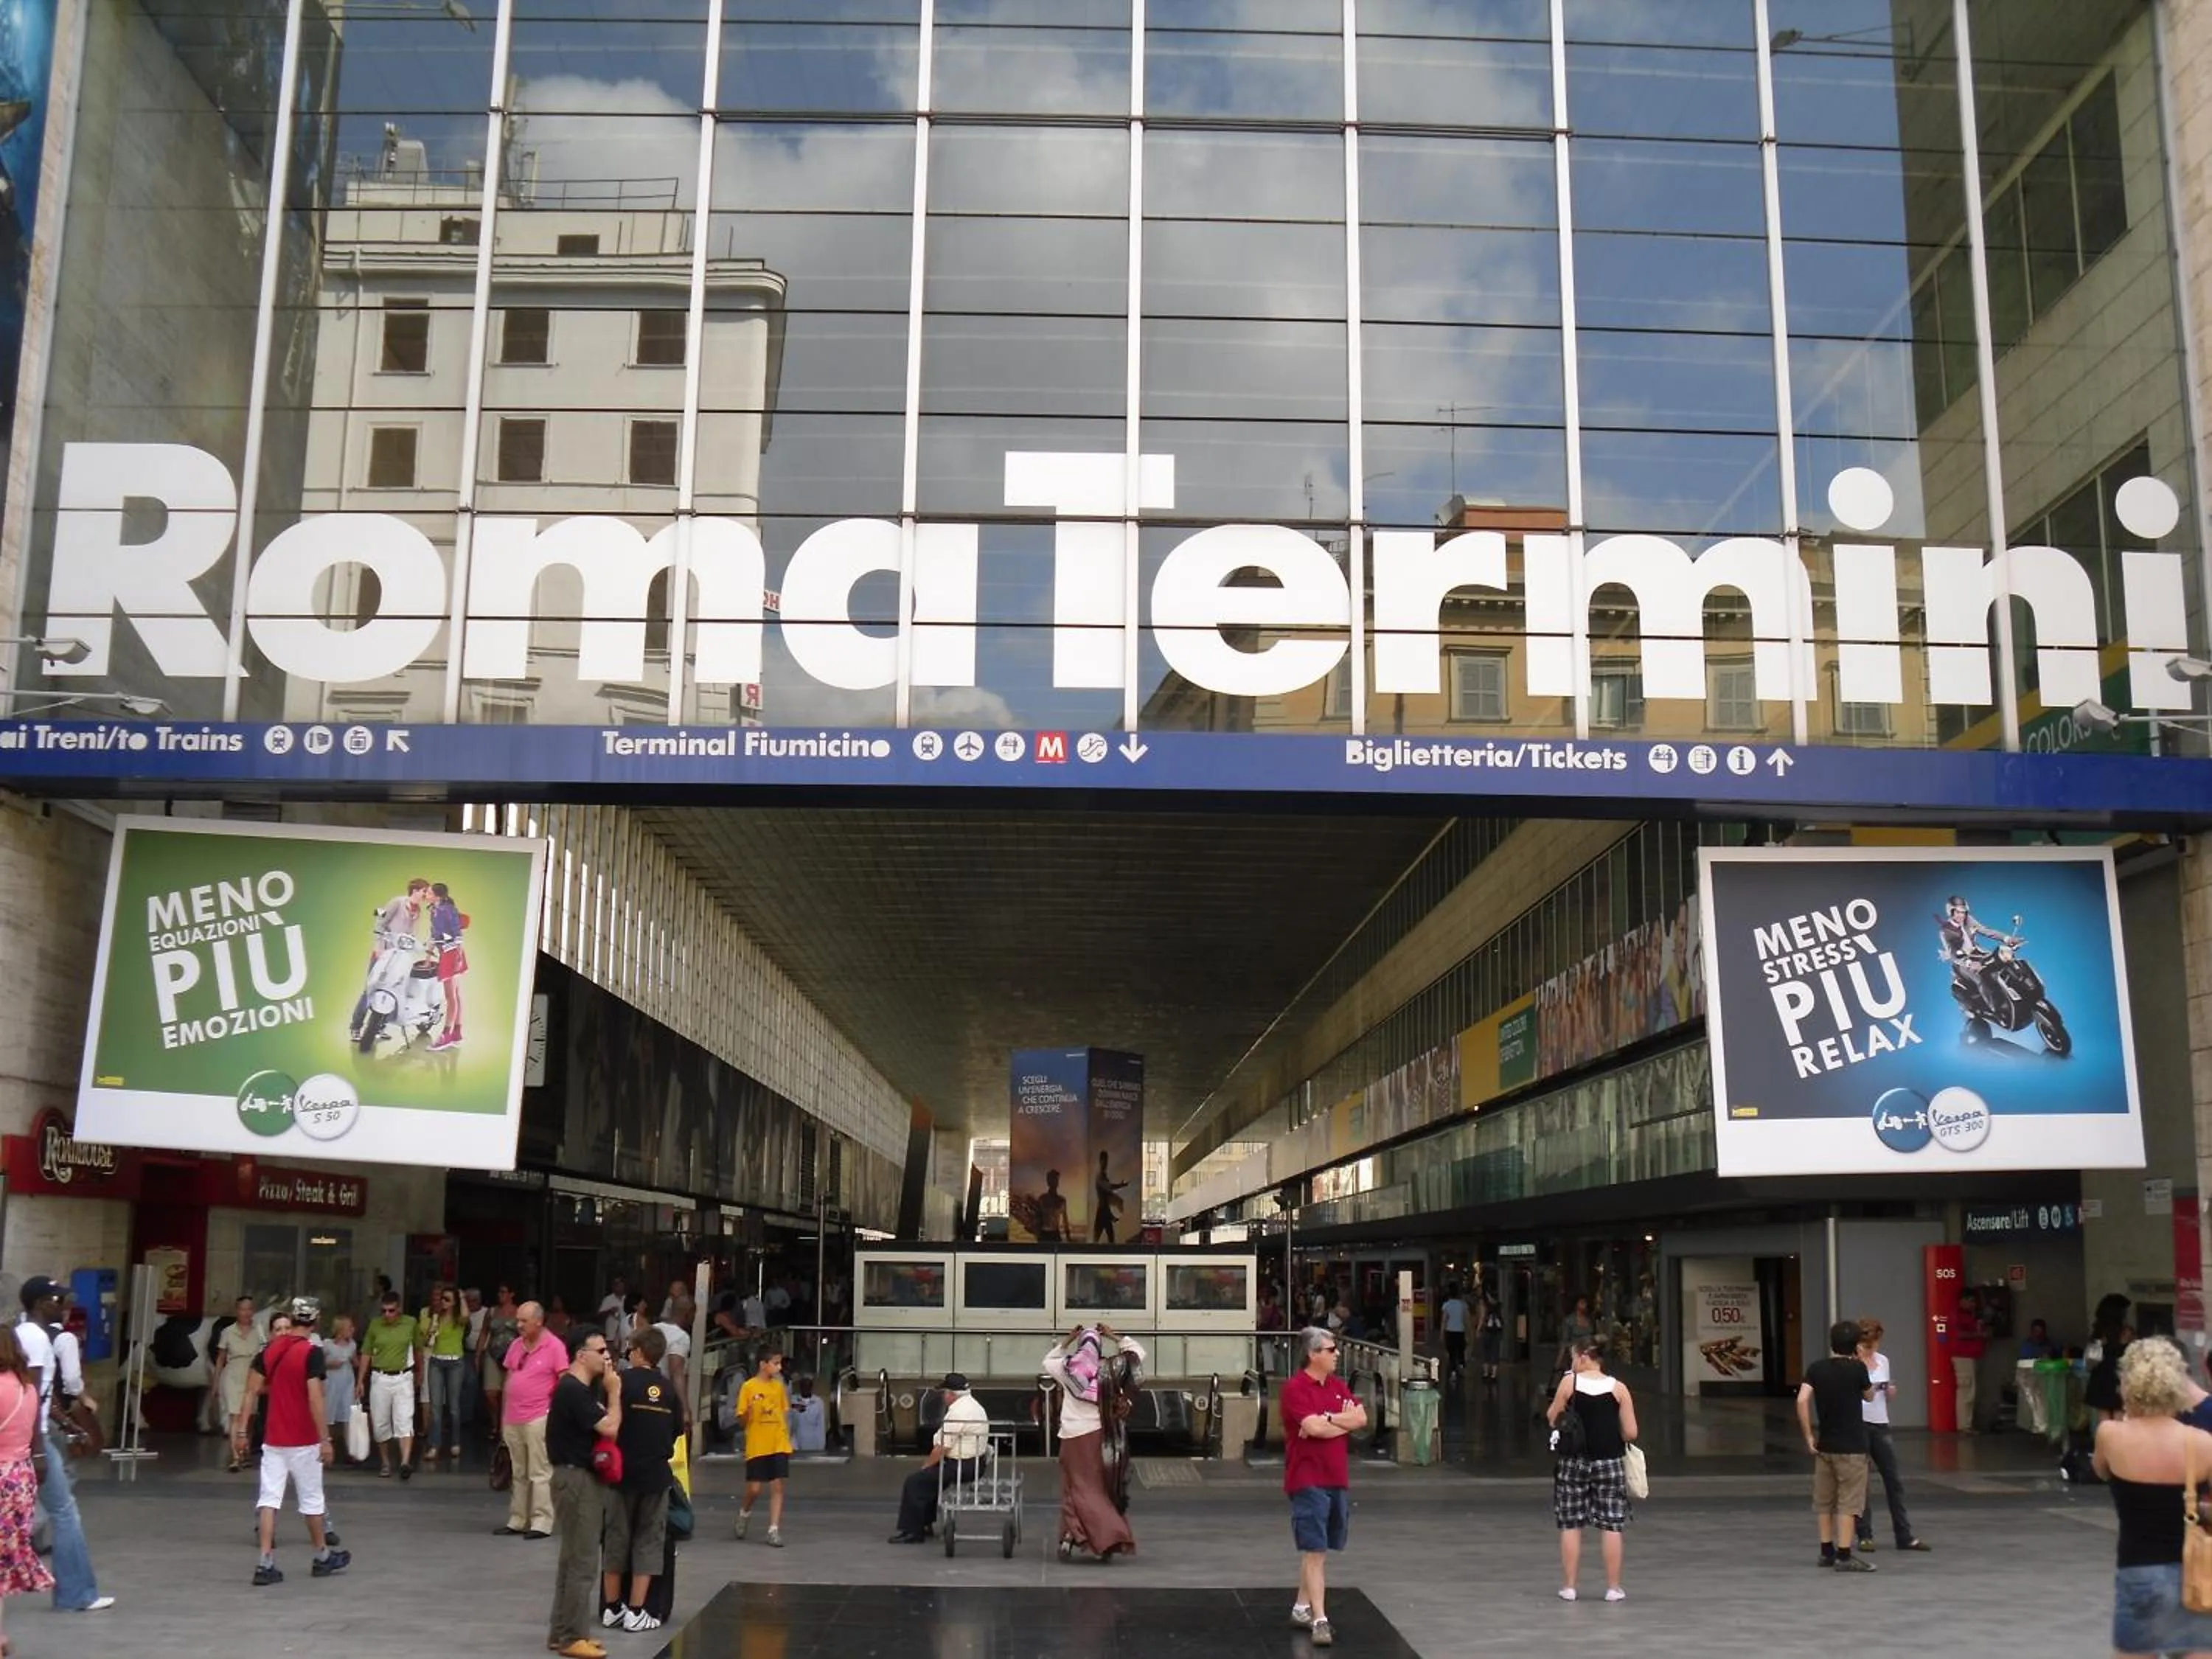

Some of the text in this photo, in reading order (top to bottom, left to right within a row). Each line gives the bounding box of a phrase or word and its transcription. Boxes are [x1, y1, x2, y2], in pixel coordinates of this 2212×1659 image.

[43, 442, 2192, 710] Roma Termini
[34, 725, 147, 751] Treni/to
[156, 726, 243, 751] Trains
[602, 731, 891, 758] Terminal Fiumicino
[1346, 740, 1627, 772] Biglietteria/Tickets
[147, 870, 295, 933] MENO
[148, 914, 261, 952] EQUAZIONI
[1753, 898, 1878, 961] MENO
[151, 911, 307, 1024] PIÙ
[1762, 938, 1857, 983] STRESS
[1770, 933, 1907, 1047] PIÙ
[161, 996, 316, 1049] EMOZIONI
[1790, 1013, 1924, 1079] RELAX
[1931, 1108, 1986, 1127] Vespa
[1940, 1120, 1984, 1138] GTS 300
[1935, 1268, 1956, 1279] SOS
